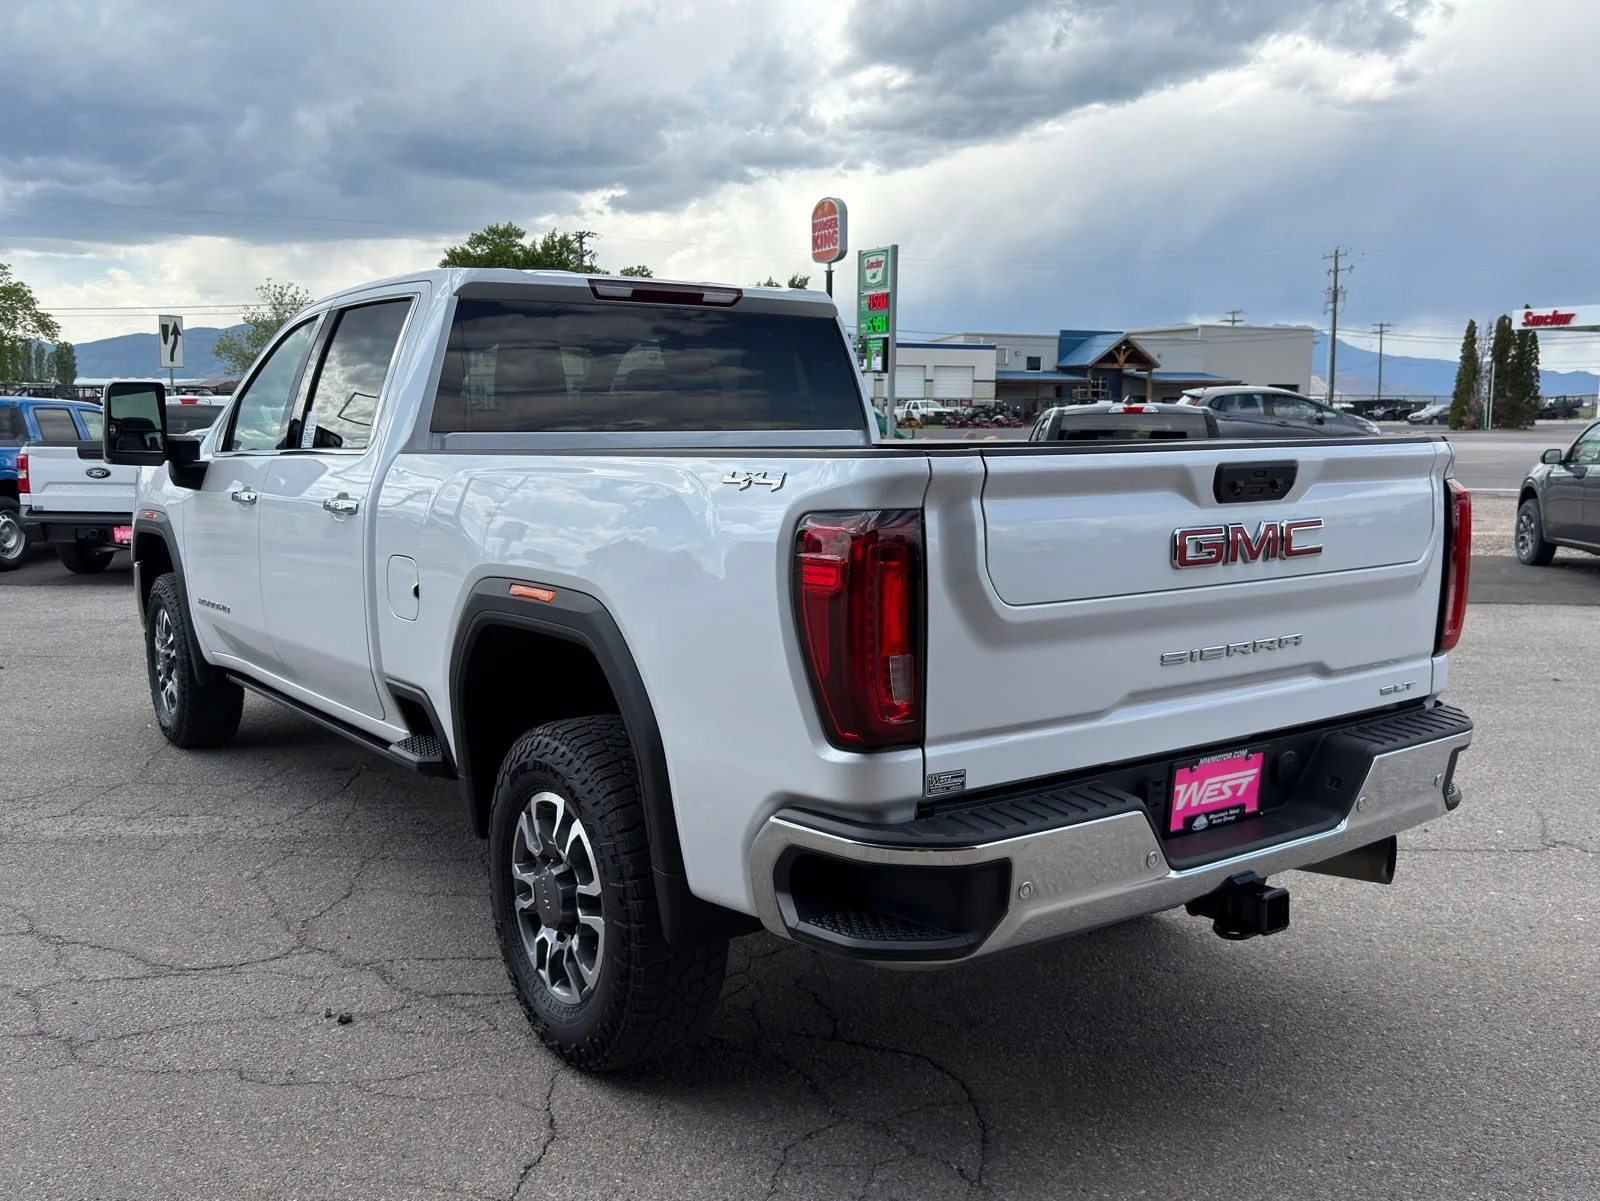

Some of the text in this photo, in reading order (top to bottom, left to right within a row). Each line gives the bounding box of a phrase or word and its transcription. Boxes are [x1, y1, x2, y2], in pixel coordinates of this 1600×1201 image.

[812, 217, 838, 233] BURGER
[812, 230, 838, 251] KING
[1522, 310, 1576, 327] Sinclair
[1171, 516, 1324, 569] GMC
[1160, 633, 1303, 667] SIERRA
[1380, 680, 1416, 696] SLT
[1199, 749, 1249, 766] MWMOTOR.COM
[1175, 768, 1259, 811] WEST
[1208, 811, 1228, 820] Mountain
